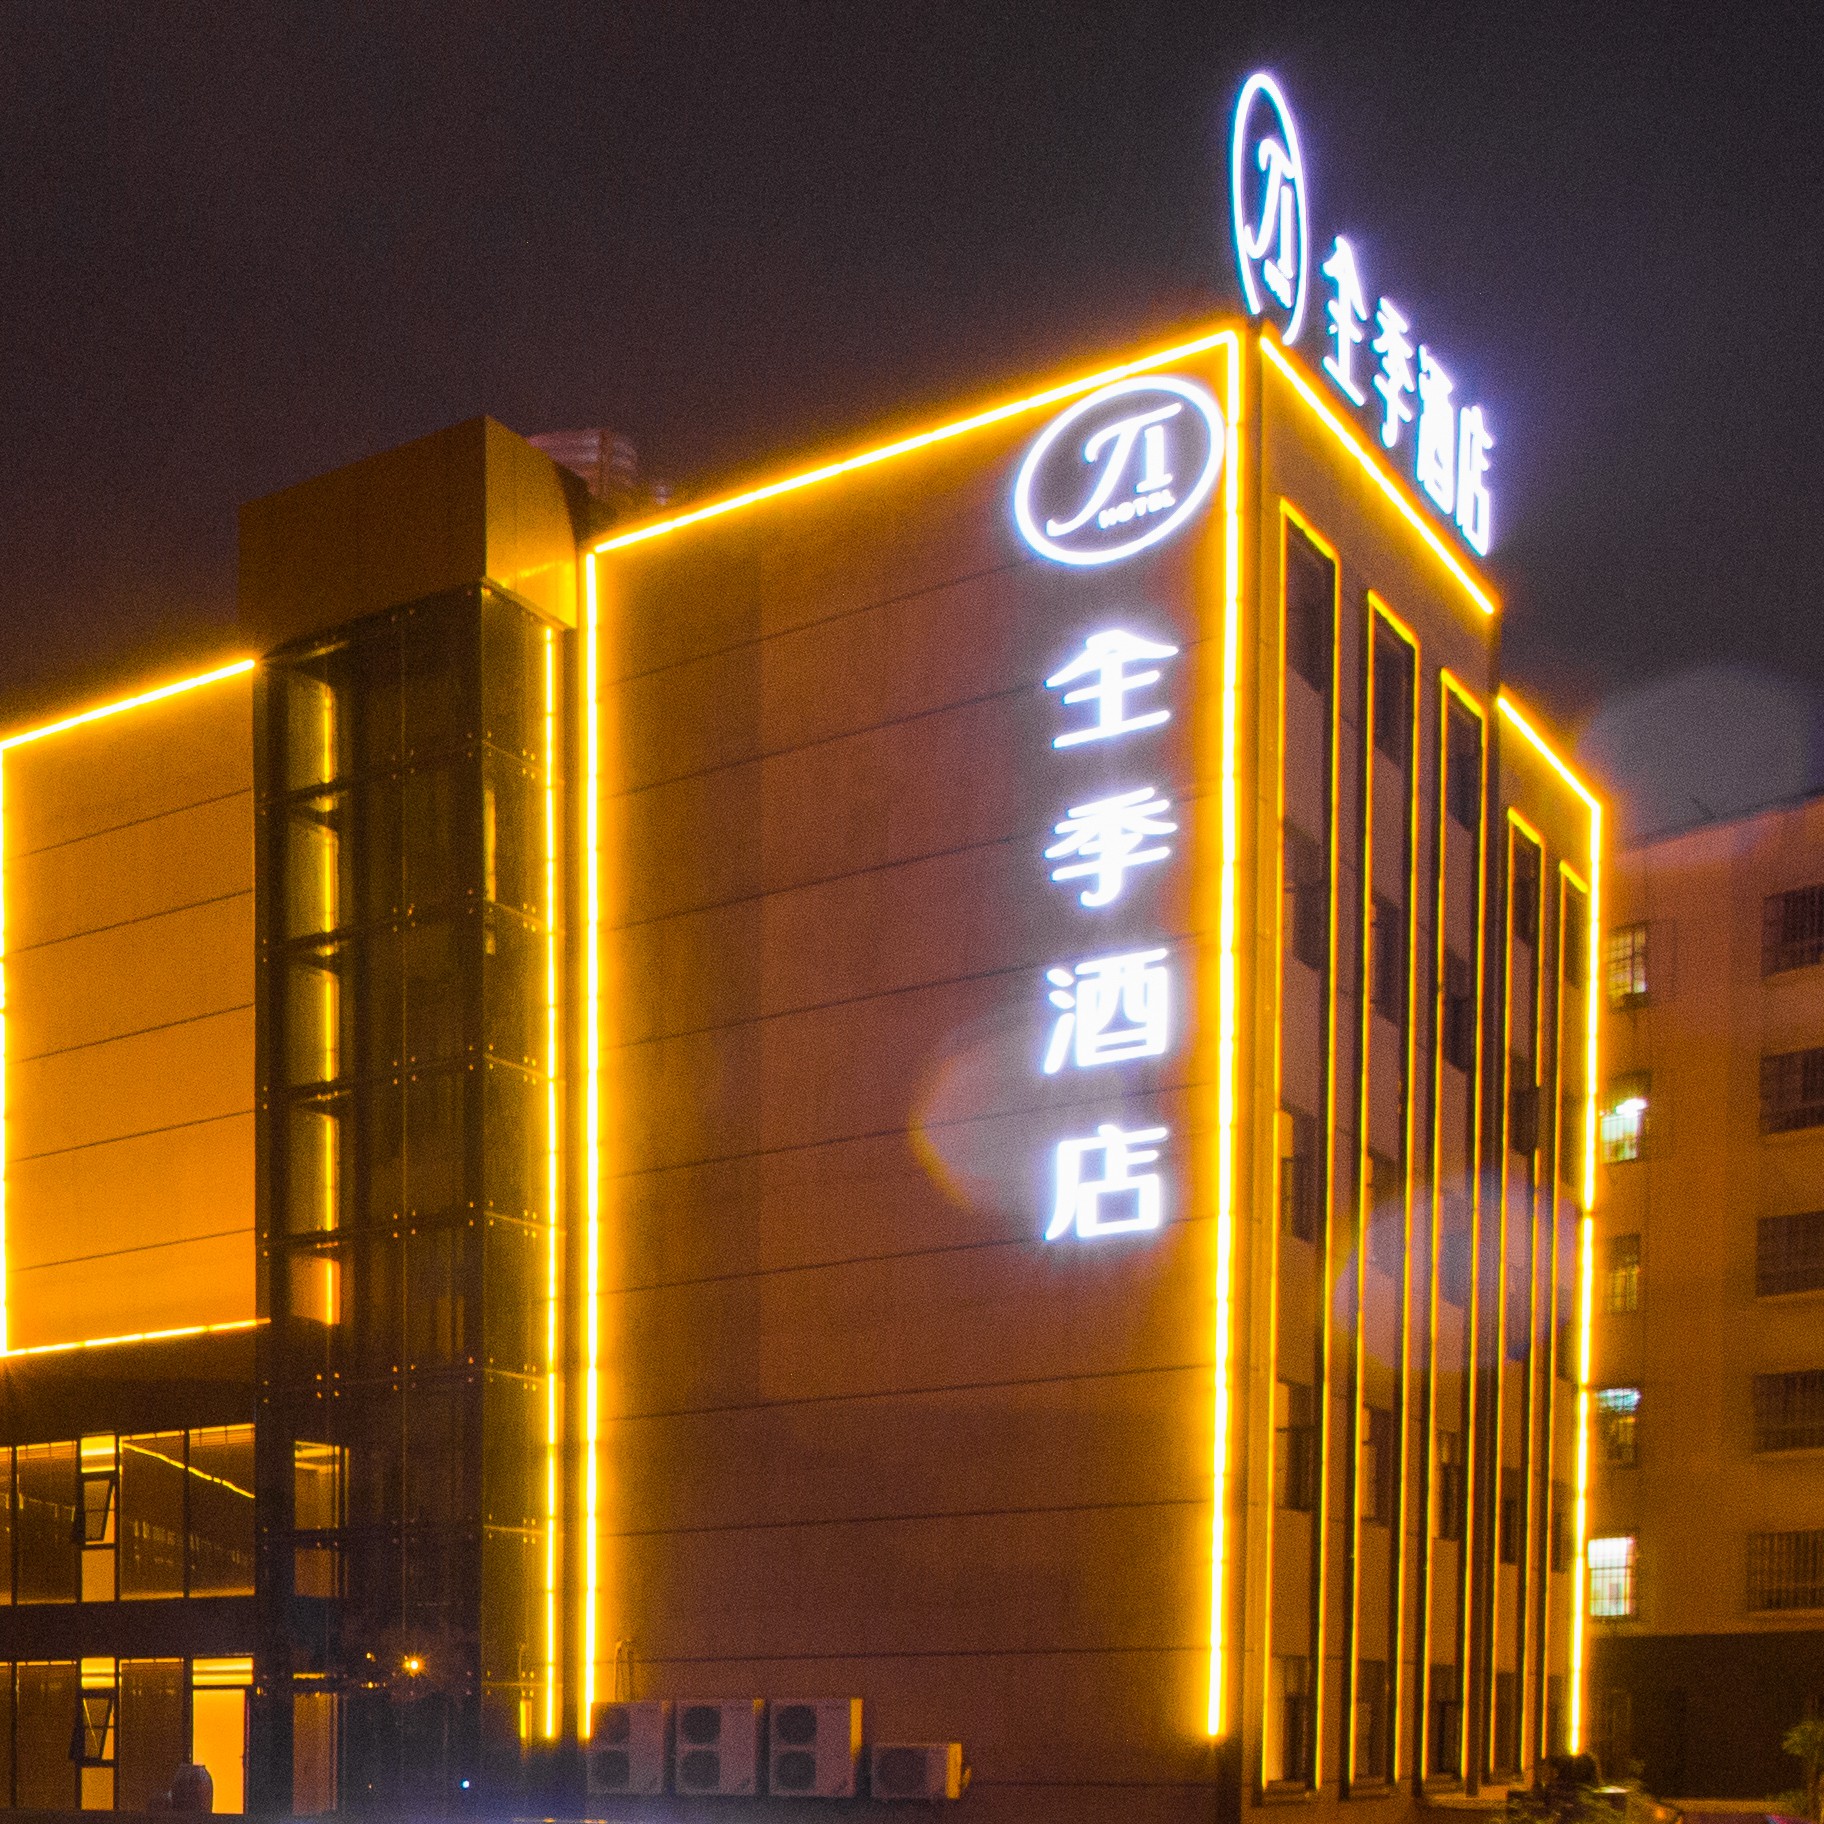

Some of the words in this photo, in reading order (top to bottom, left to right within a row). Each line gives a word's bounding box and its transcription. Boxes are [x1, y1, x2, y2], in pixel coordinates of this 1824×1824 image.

[1324, 236, 1494, 557] 全季酒店
[1044, 628, 1180, 1241] 全季酒店
